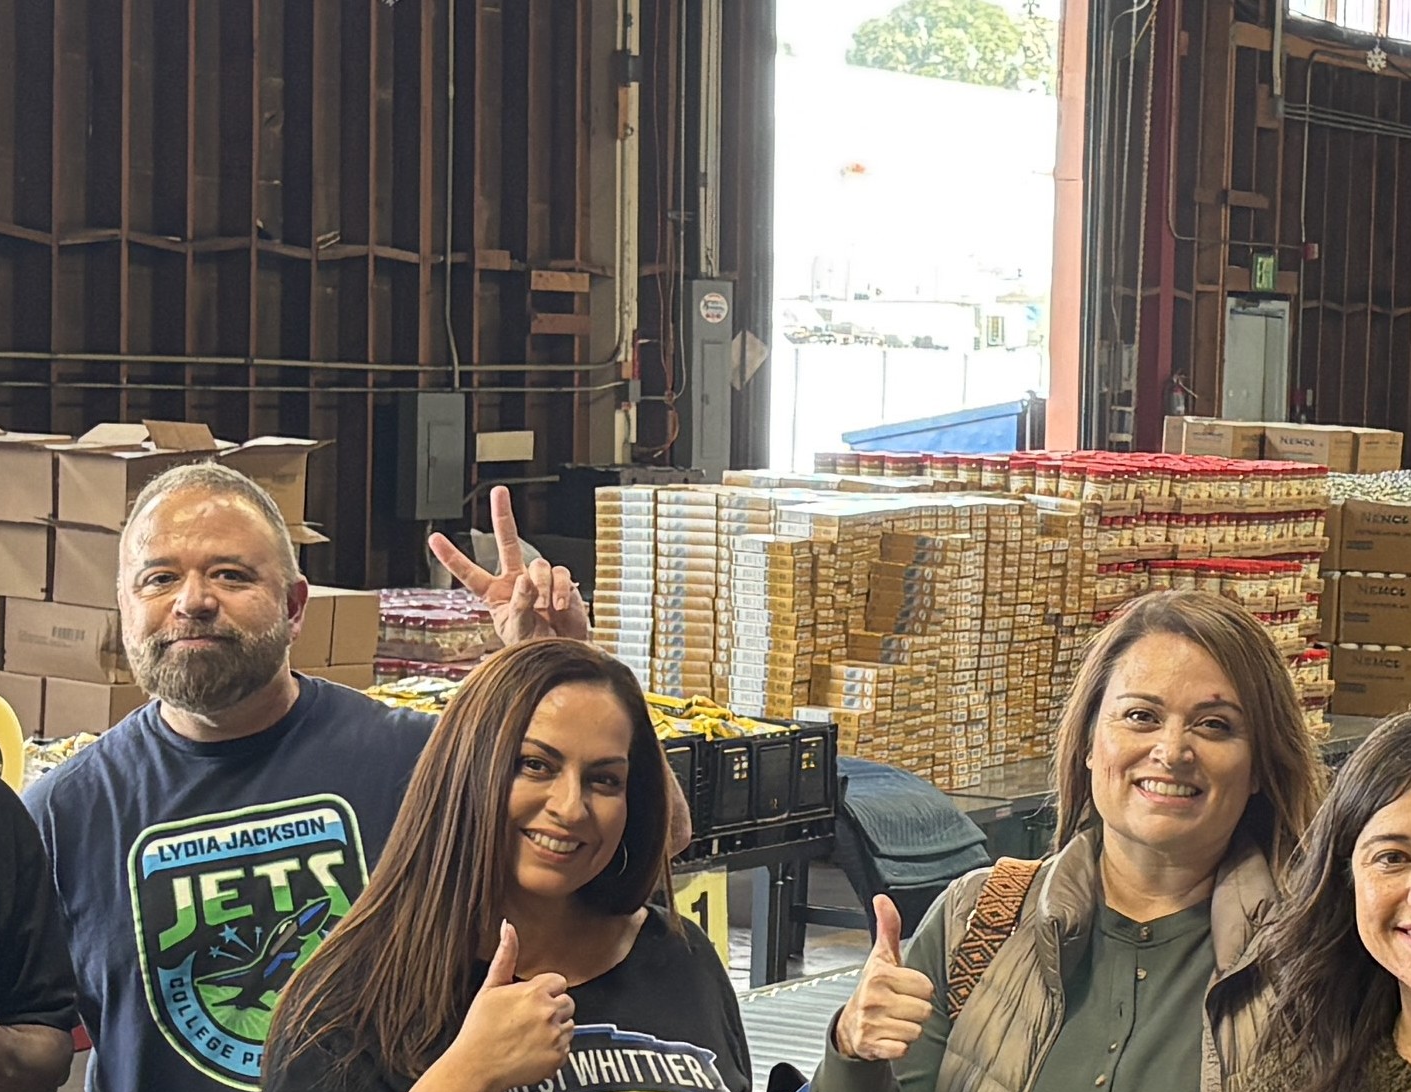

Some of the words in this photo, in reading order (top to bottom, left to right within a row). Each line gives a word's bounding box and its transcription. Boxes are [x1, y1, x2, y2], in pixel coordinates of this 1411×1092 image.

[157, 836, 221, 863] LYDIA
[222, 816, 327, 849] JACKSON
[158, 850, 351, 951] JETS
[169, 976, 235, 1060] COLLEGE
[568, 1049, 715, 1090] WHITTIER
